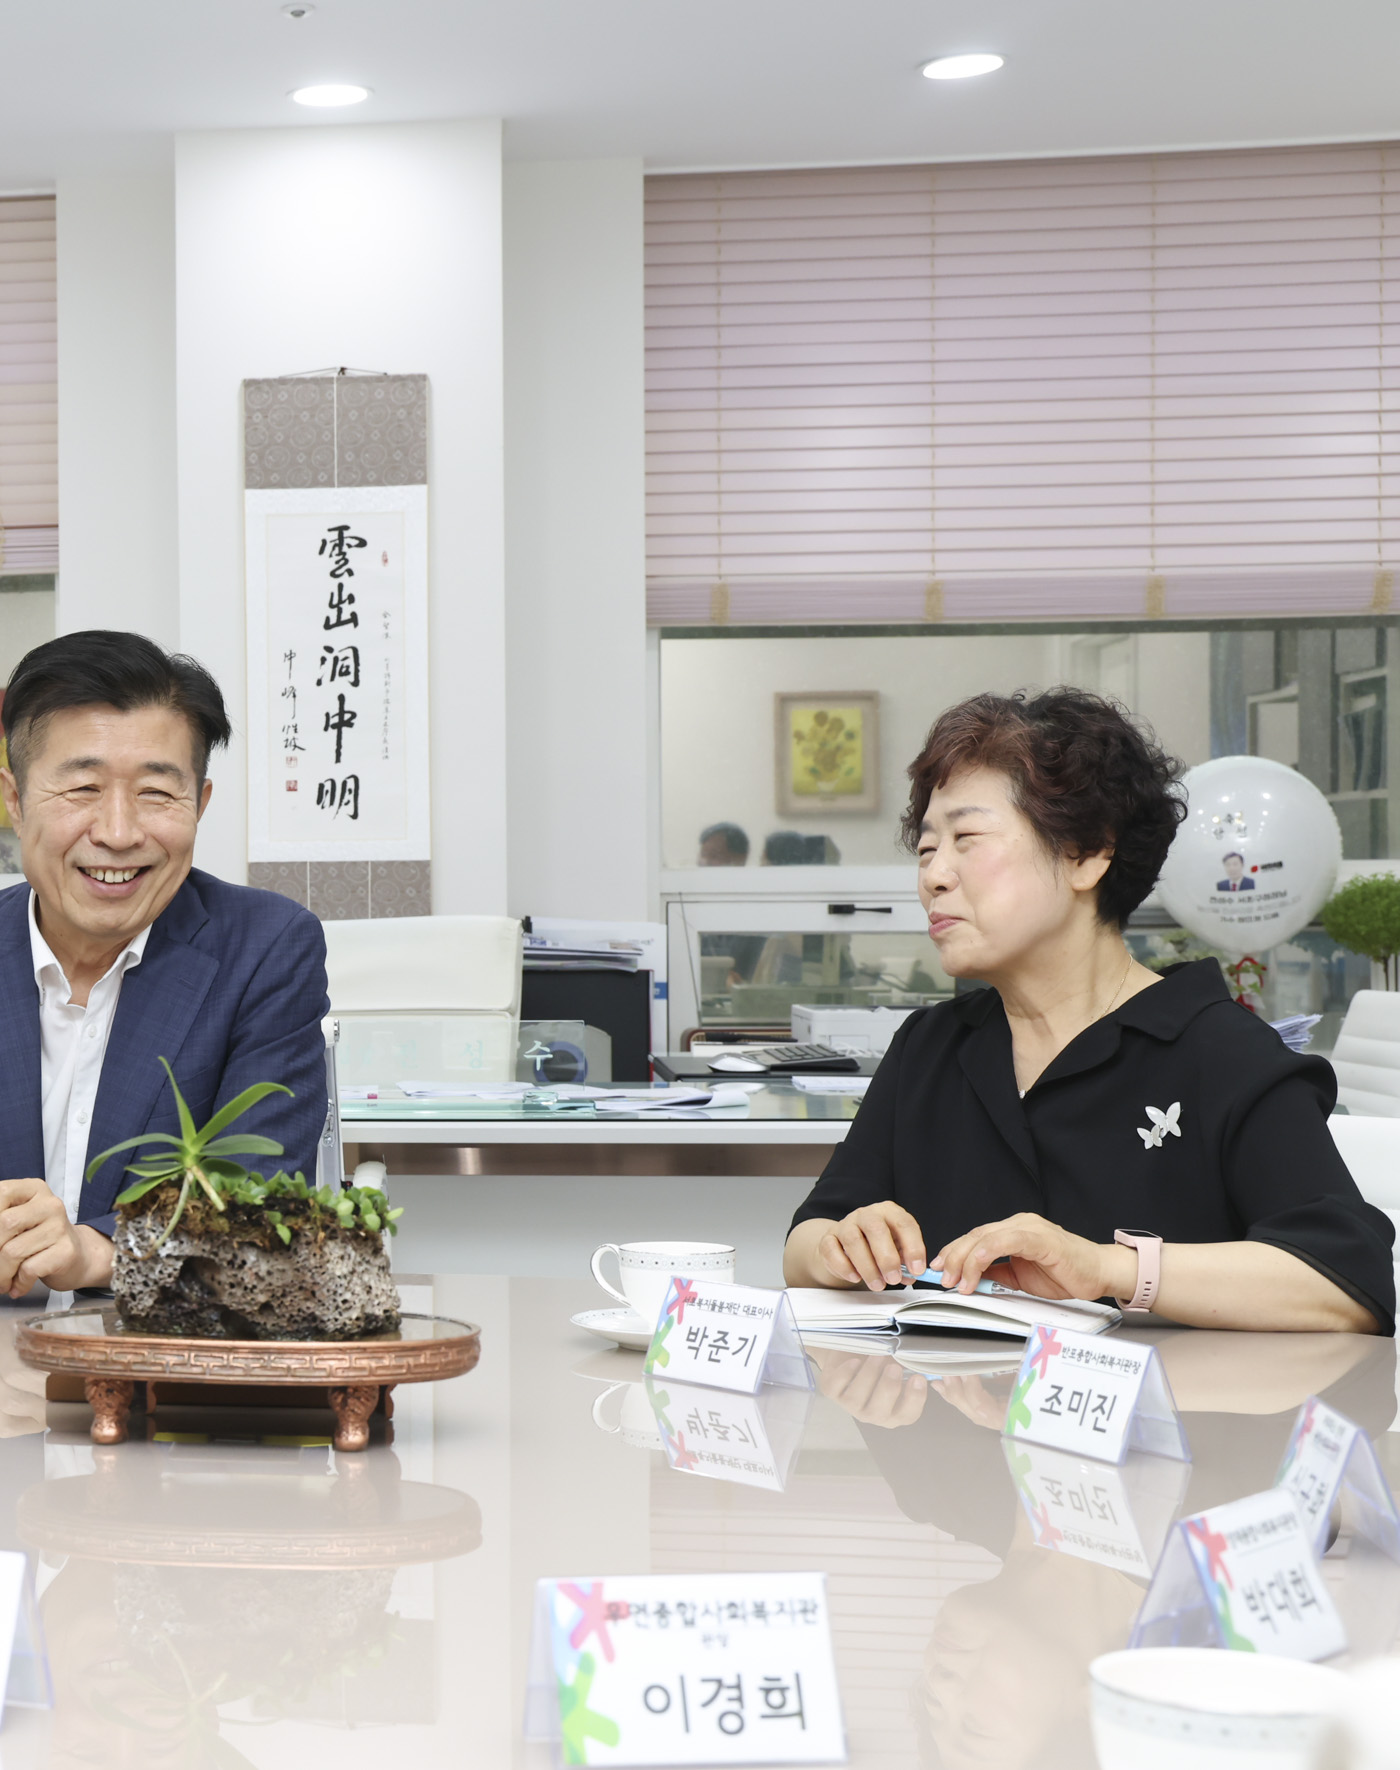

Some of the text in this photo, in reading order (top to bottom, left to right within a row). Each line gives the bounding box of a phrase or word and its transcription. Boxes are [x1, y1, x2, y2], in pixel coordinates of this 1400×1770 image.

[316, 524, 368, 821] 雲出洞中明
[683, 1295, 774, 1320] 서초복지돌봄재단 대표이사
[685, 1324, 758, 1367] 박준기
[1061, 1346, 1142, 1375] 반포종합사회복지관장
[1040, 1383, 1118, 1434] 조미진
[643, 1671, 807, 1737] 이경희
